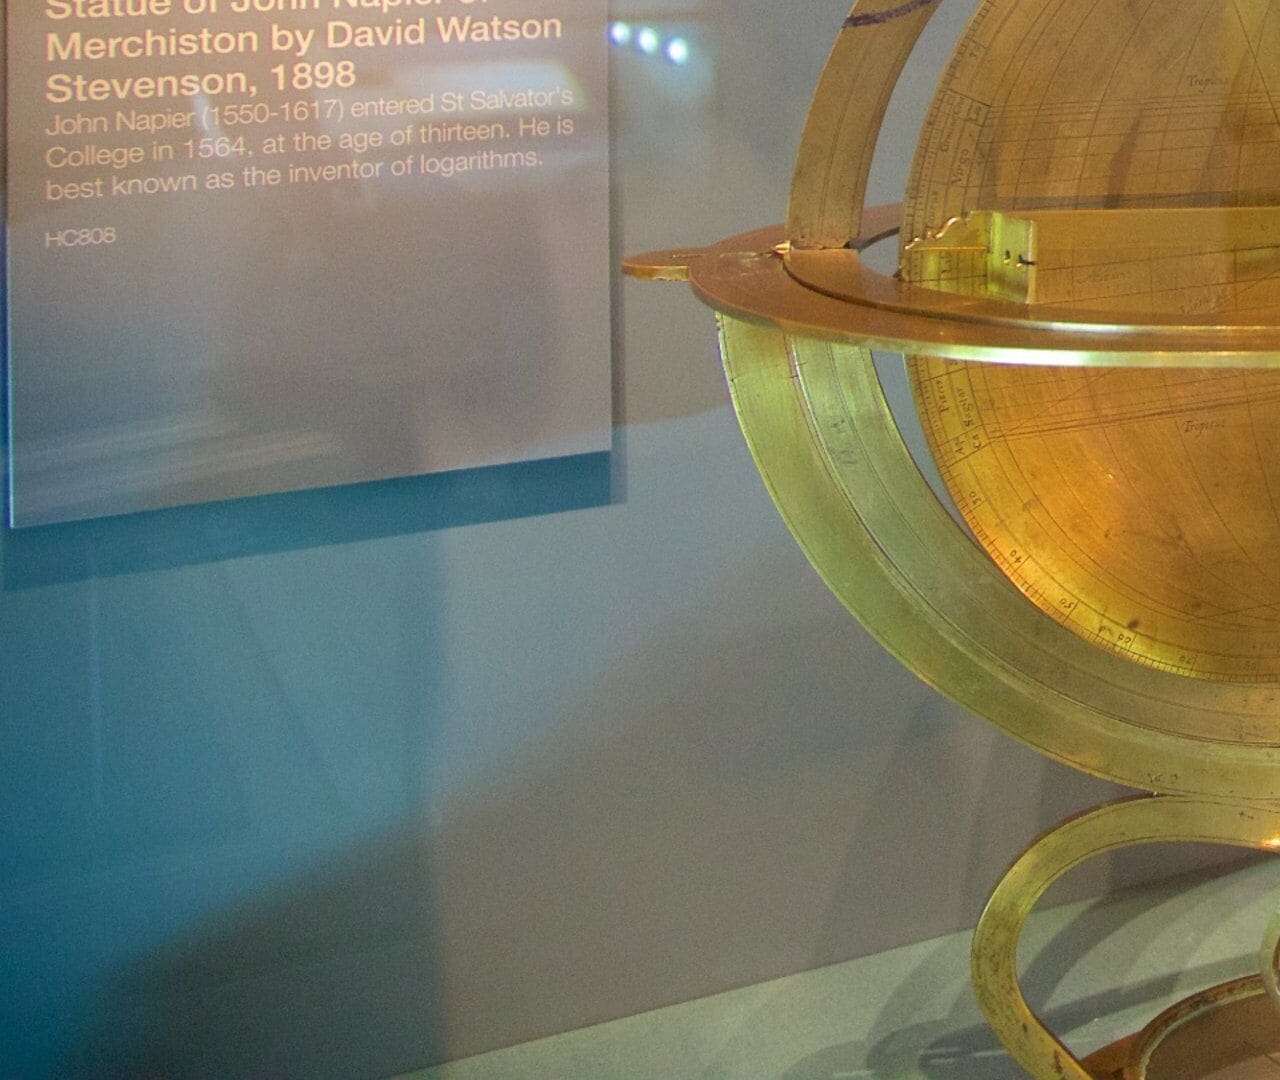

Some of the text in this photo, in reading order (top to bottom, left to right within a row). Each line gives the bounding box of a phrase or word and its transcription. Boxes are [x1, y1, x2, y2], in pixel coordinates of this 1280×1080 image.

[46, 15, 562, 60] Merchiston by David Watson
[45, 60, 356, 102] Stevenson, 1898
[44, 85, 576, 137] John Napier (1550-1617) entered St Salvator's
[44, 114, 574, 169] College in 1564, at the age of thirteen. He is
[45, 149, 544, 200] best known as the inventor of logarithms.
[45, 225, 117, 248] HC808
